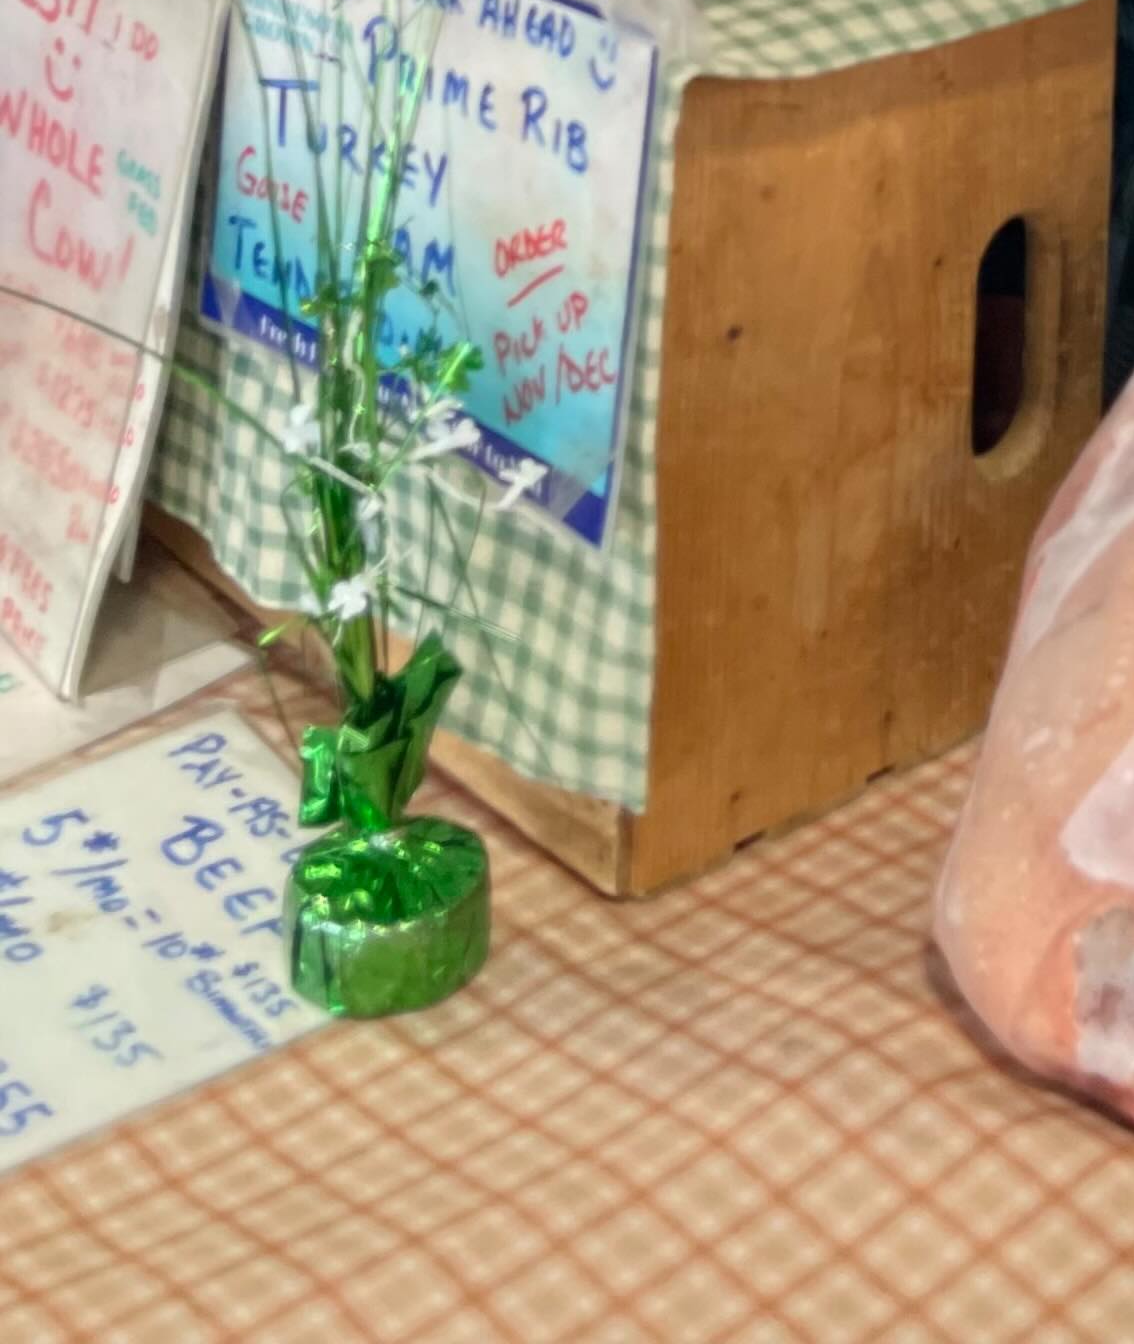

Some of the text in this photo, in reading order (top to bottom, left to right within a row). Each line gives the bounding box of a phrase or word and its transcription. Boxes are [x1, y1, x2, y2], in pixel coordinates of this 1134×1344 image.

[0, 90, 105, 198] WHOLE
[521, 85, 588, 174] RIB
[393, 226, 455, 298] AM
[494, 218, 566, 278] ORDER
[558, 291, 588, 334] UP
